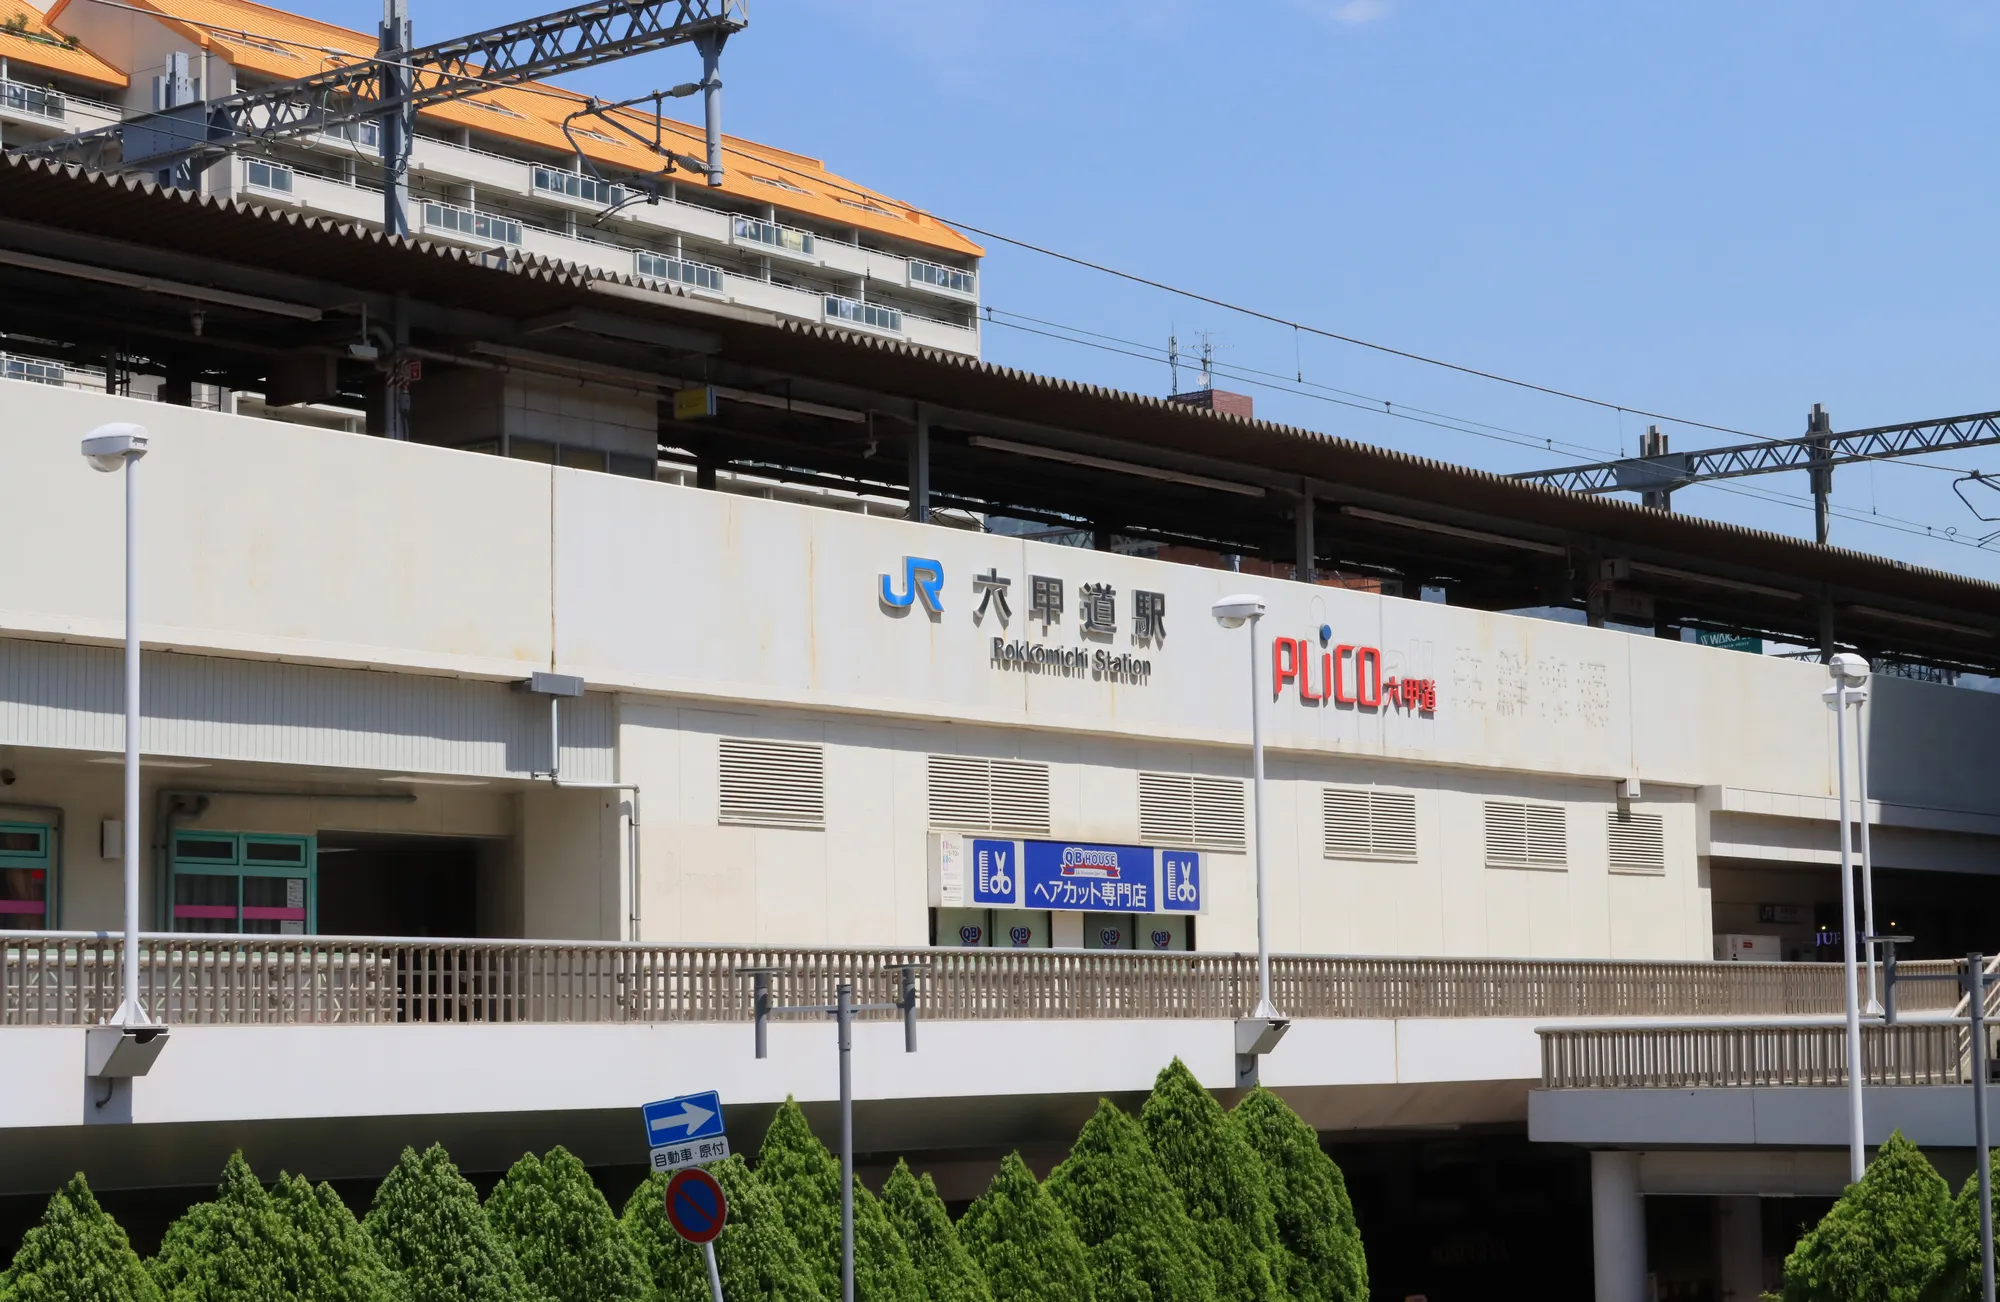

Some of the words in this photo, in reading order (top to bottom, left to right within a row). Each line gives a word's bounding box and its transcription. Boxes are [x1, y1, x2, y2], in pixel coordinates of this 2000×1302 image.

[878, 556, 945, 612] JR
[973, 567, 1167, 640] 六甲道駅
[1092, 649, 1151, 677] Station
[1383, 676, 1437, 712] 六甲道
[1064, 849, 1083, 867] QB
[1084, 852, 1116, 867] HOUSE
[1033, 880, 1147, 908] ヘアカット専門店
[962, 927, 978, 941] QB
[1012, 927, 1027, 942] QB
[1103, 929, 1117, 943] QB
[1154, 930, 1168, 944] QB
